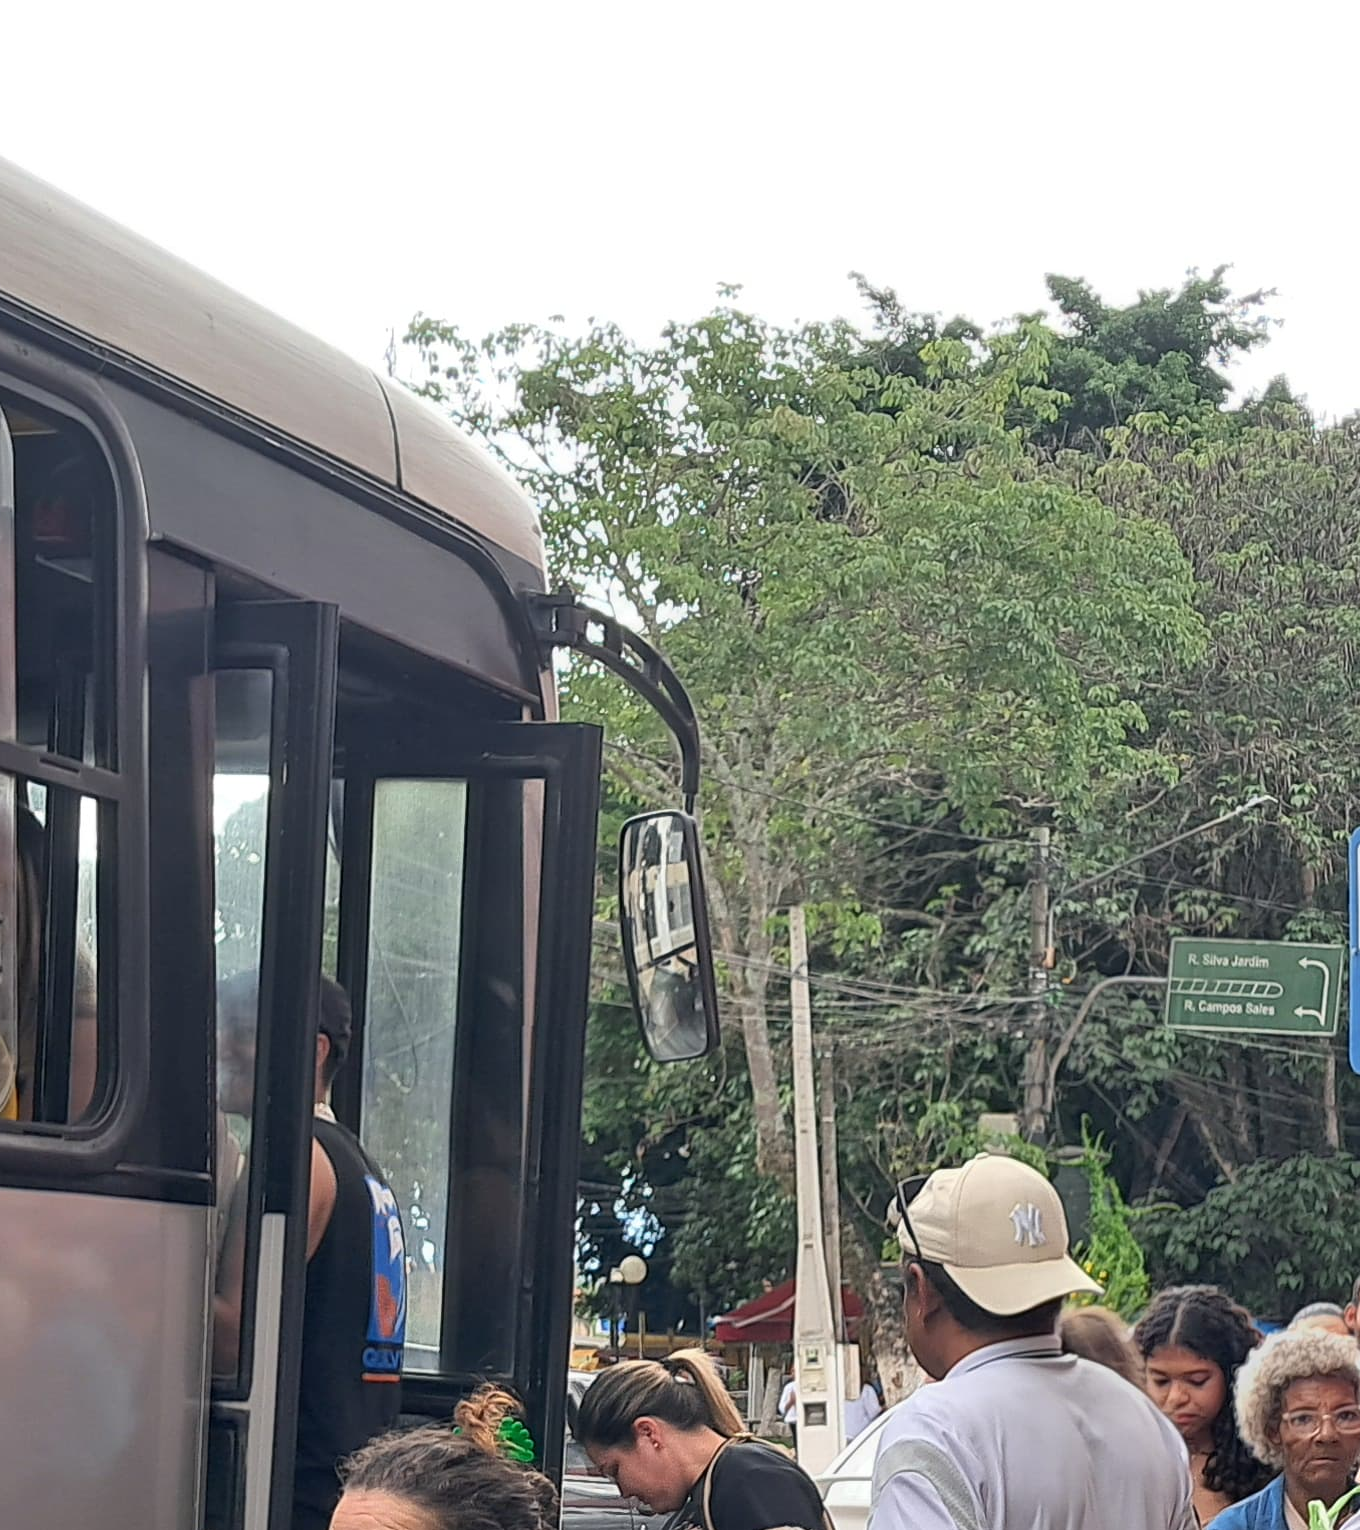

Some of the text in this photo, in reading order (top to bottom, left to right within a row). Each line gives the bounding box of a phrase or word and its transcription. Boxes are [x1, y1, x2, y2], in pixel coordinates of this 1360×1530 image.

[1188, 954, 1269, 969] R. Silva Jardim
[1184, 1000, 1275, 1016] R. Campos Sales
